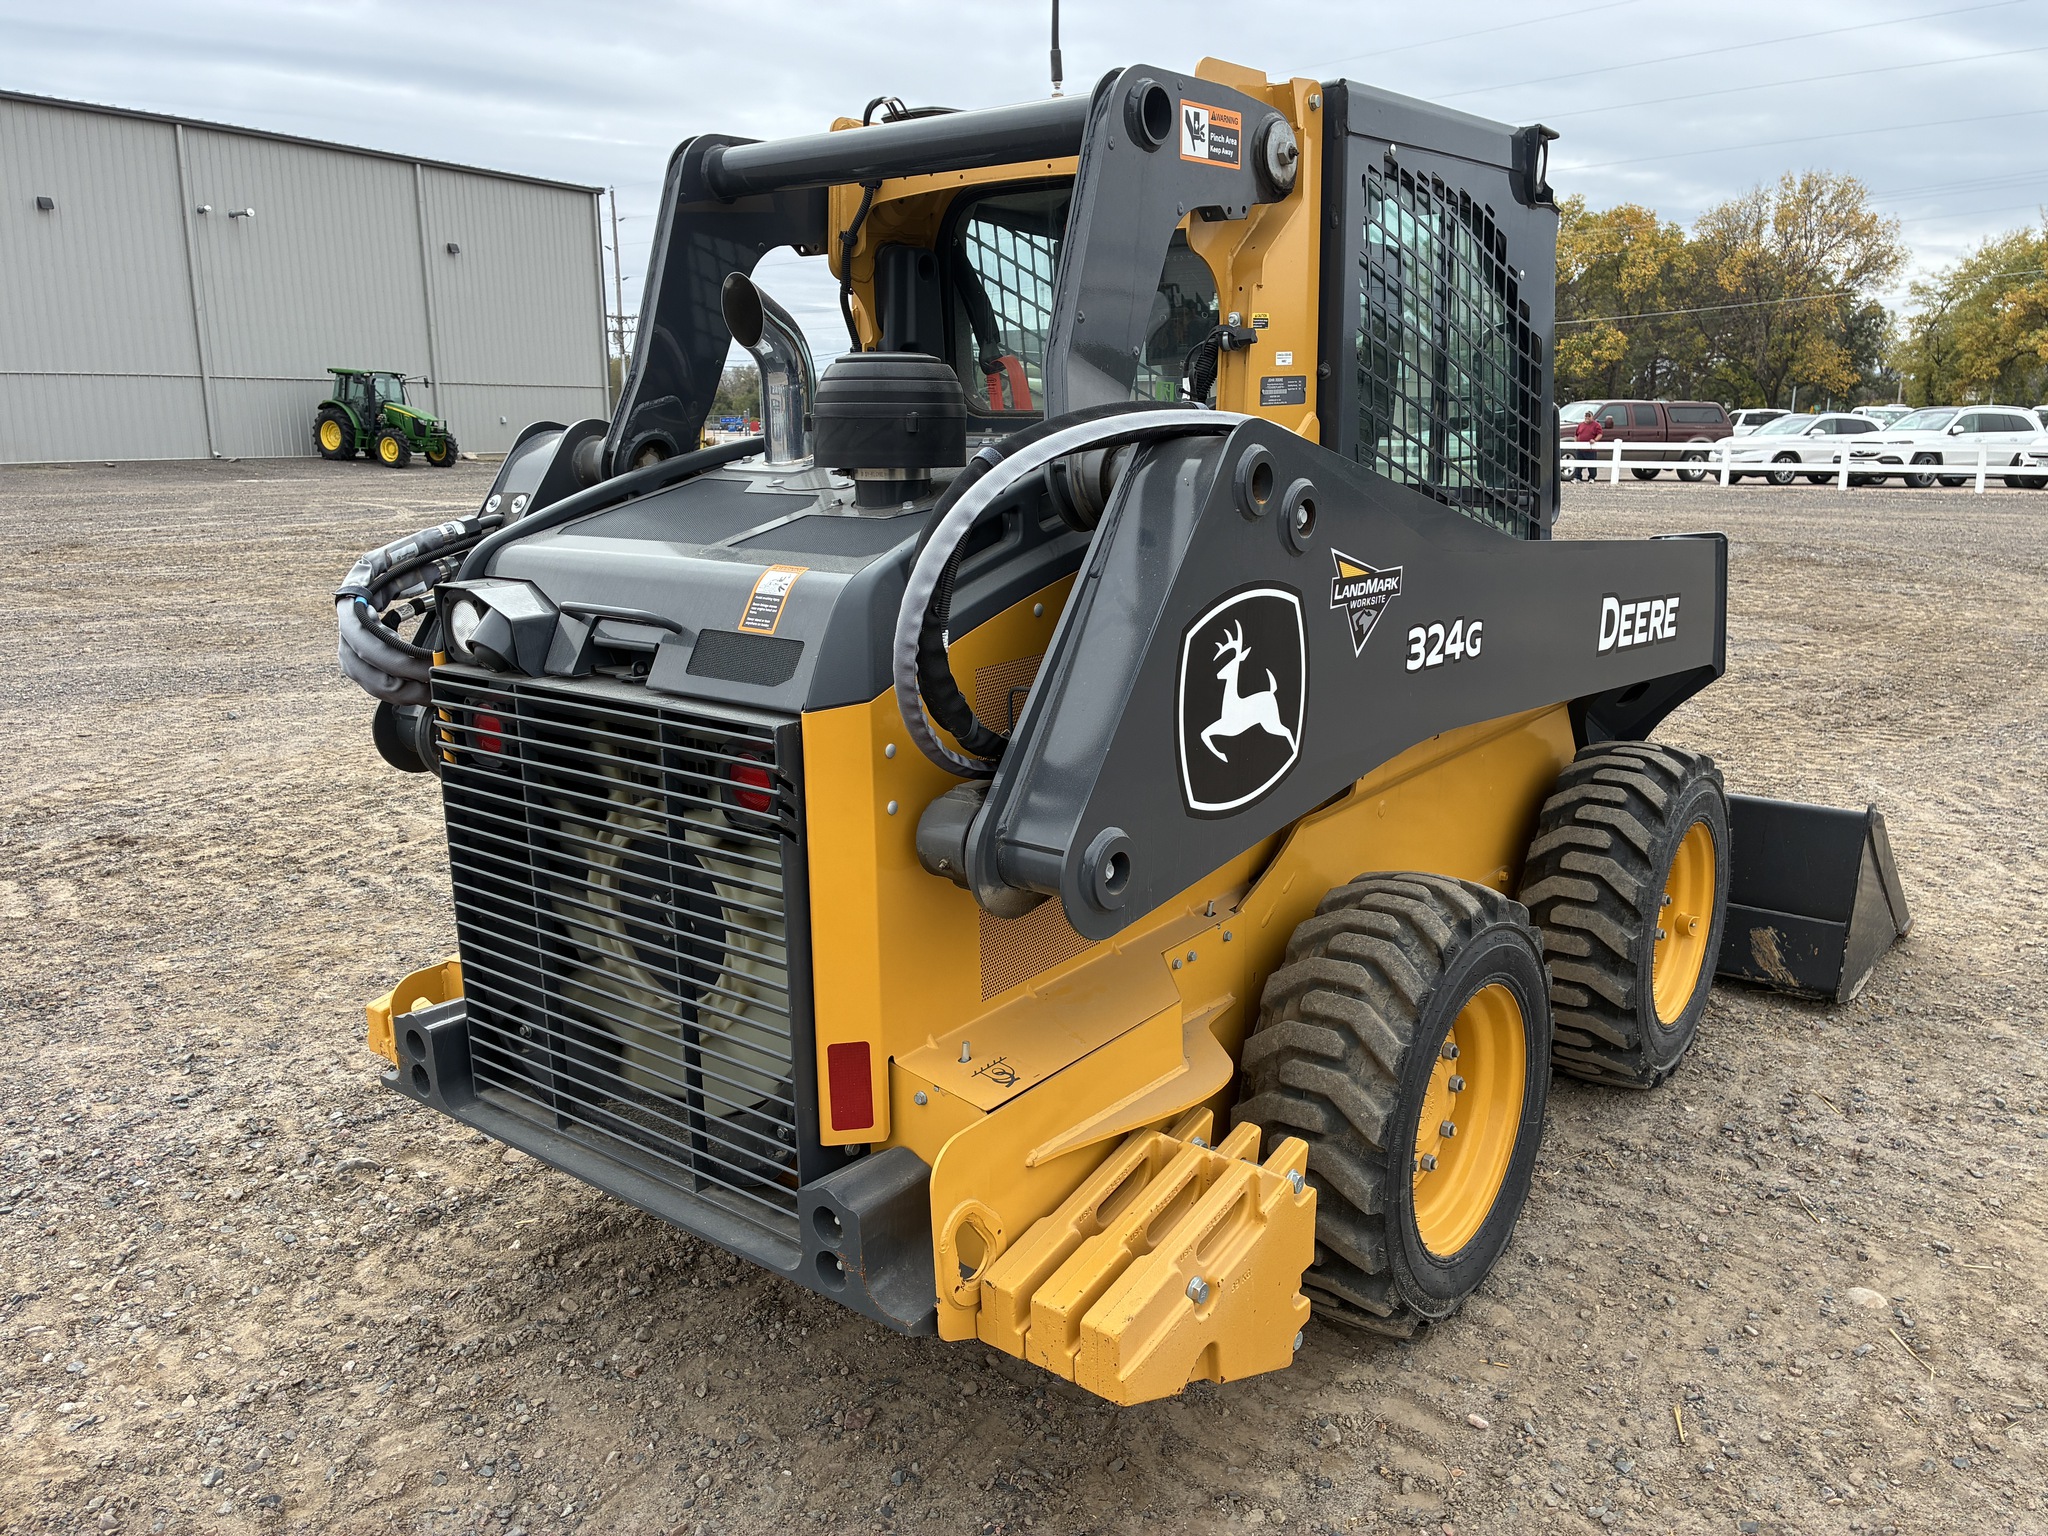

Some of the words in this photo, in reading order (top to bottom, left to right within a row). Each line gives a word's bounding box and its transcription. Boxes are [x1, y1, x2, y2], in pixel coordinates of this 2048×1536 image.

[1215, 113, 1238, 125] WARNING
[1210, 132, 1225, 143] Pinch
[1225, 135, 1238, 146] Area
[1210, 145, 1221, 155] Keep
[1222, 147, 1234, 158] Away
[1334, 576, 1400, 601] LANDMARK
[1350, 594, 1386, 609] WORKSITE
[1597, 596, 1680, 652] DEERE
[1405, 618, 1484, 672] 324G
